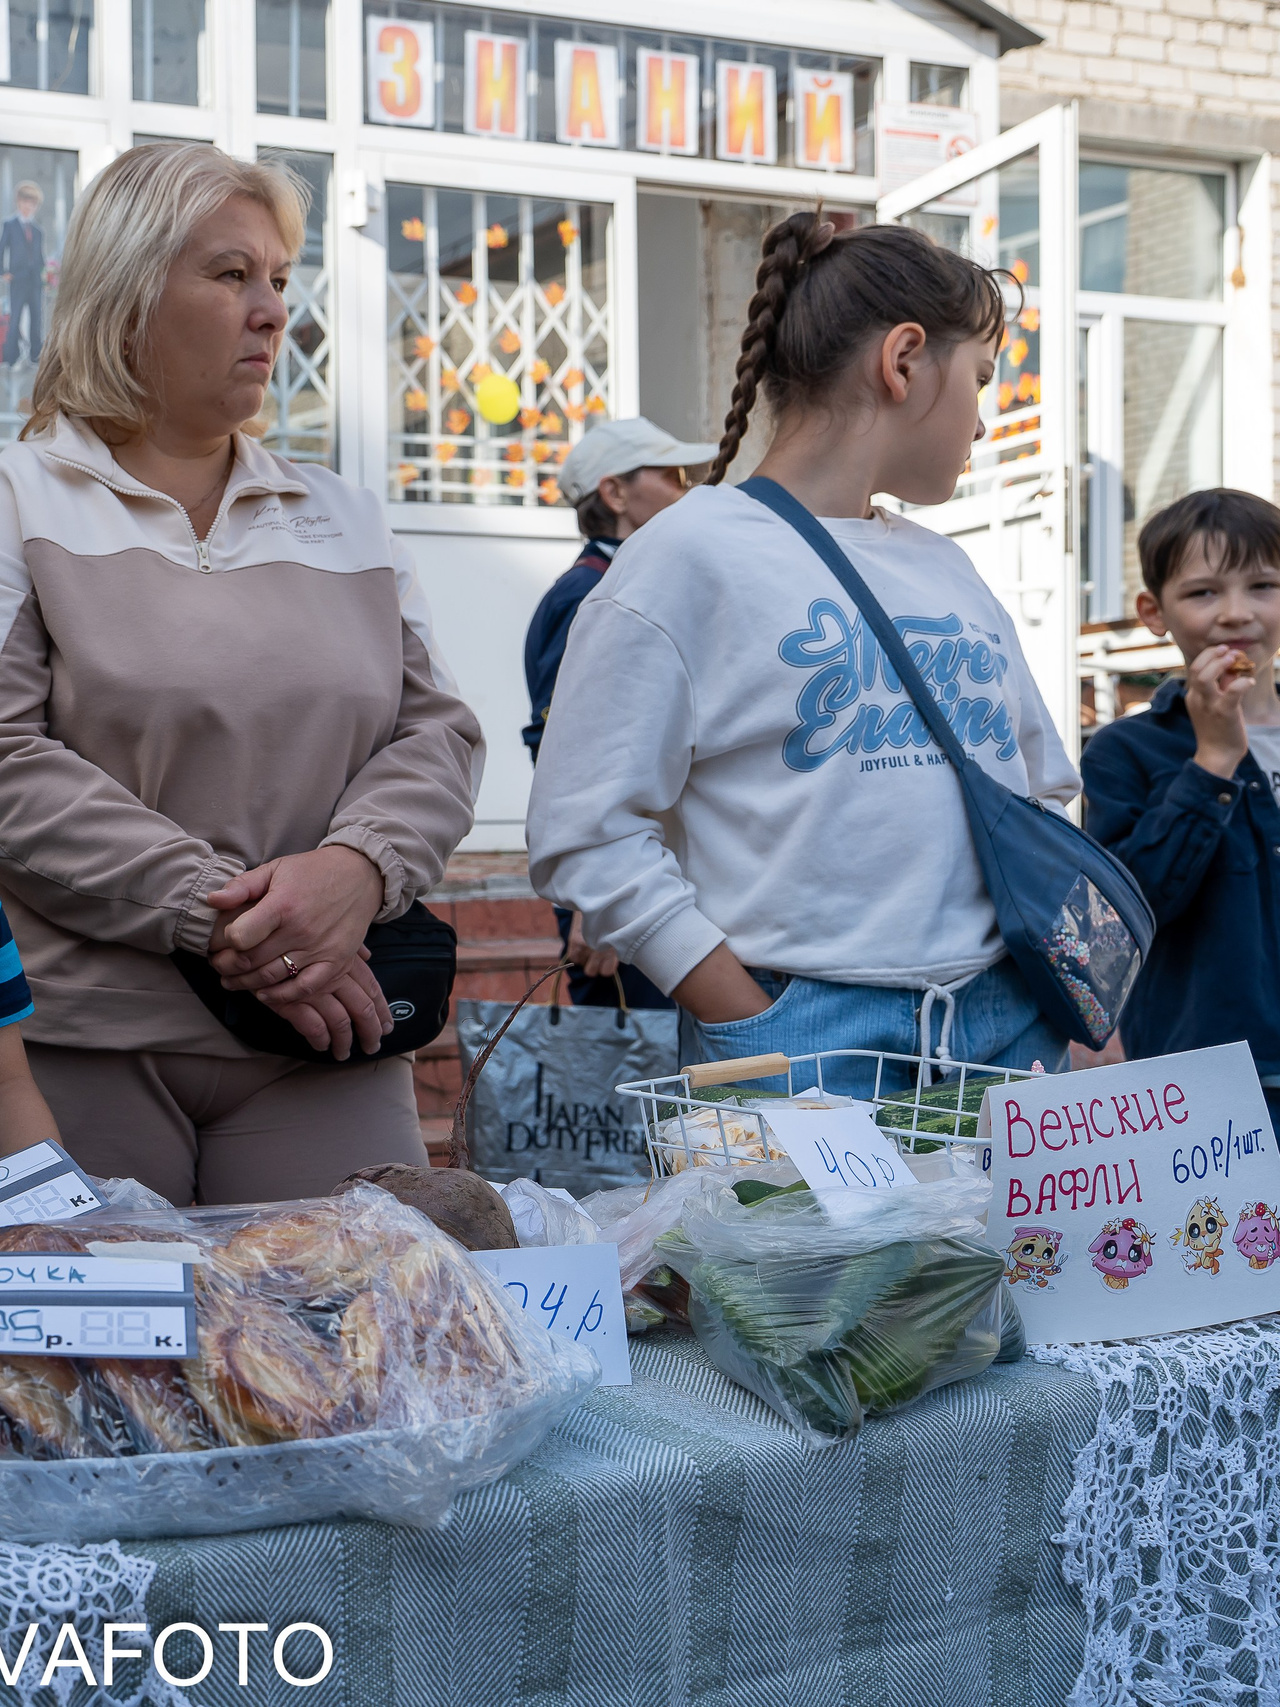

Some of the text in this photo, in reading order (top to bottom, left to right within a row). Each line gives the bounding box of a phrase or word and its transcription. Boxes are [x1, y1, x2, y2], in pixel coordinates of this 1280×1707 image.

[377, 25, 843, 165] ЗНАНИЙ
[859, 756, 910, 772] JOYFULL
[914, 754, 923, 766] &
[545, 1094, 625, 1133] JAPAN
[45, 1335, 73, 1349] р.
[155, 1335, 183, 1347] к.
